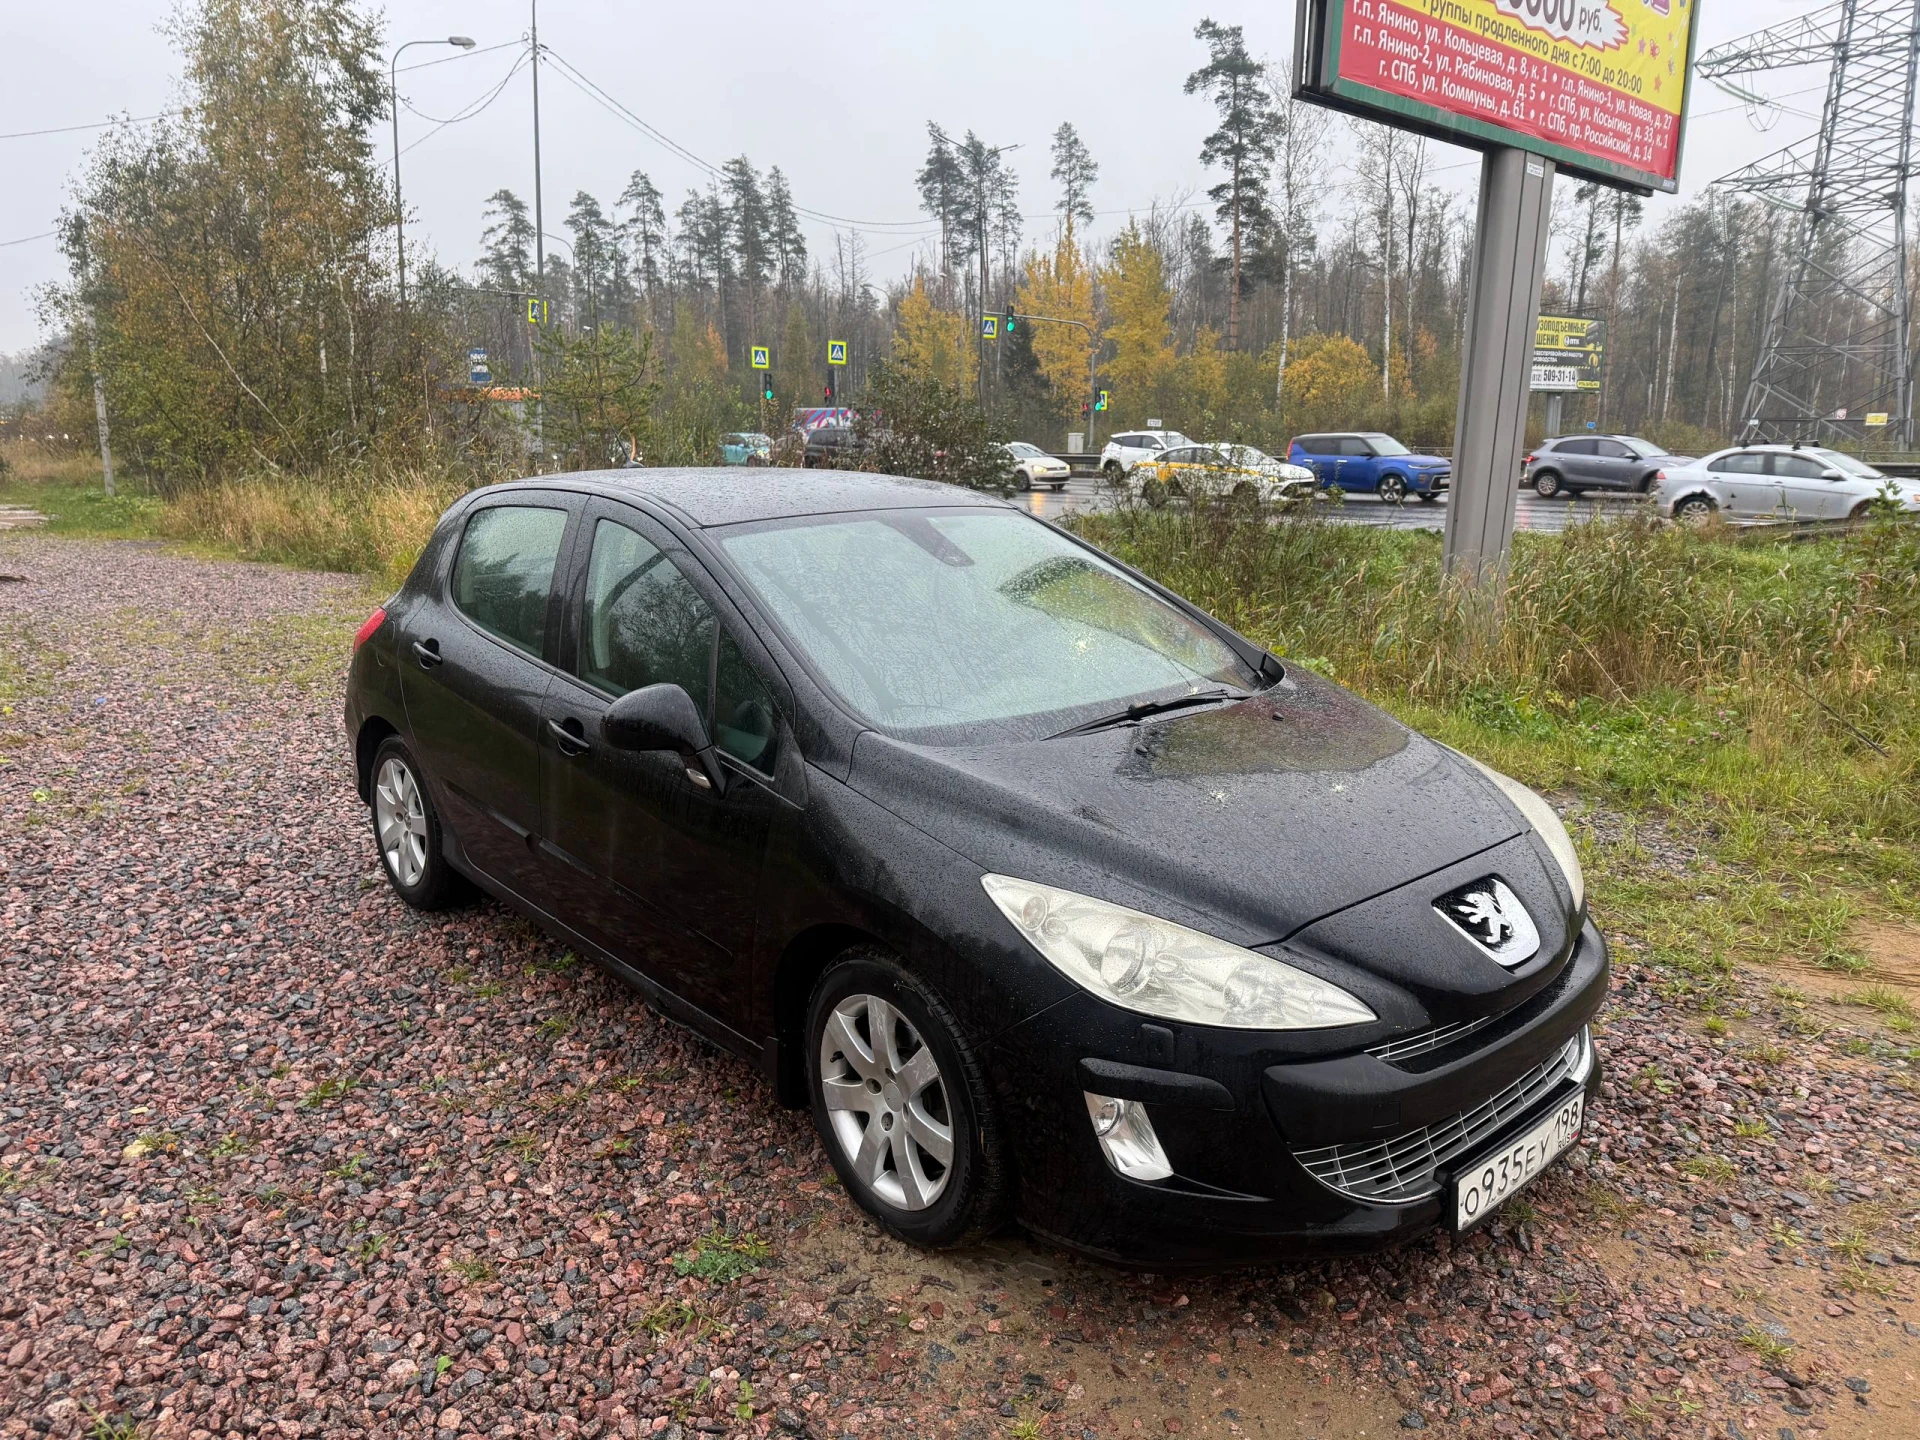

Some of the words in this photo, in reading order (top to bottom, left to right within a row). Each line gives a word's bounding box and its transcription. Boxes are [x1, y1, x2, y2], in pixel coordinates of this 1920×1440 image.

[1475, 12, 1548, 55] продленного
[1551, 46, 1570, 65] дня
[1573, 56, 1578, 68] с
[1581, 52, 1601, 76] 7:00
[1603, 66, 1615, 84] до
[1616, 72, 1642, 94] 20:00
[1579, 5, 1602, 34] руб.
[1353, 0, 1374, 20] г.п.
[1378, 3, 1421, 40] Янино,
[1425, 24, 1441, 44] ул.
[1444, 27, 1505, 69] Кольцевая,
[1507, 56, 1517, 75] д.
[1520, 57, 1529, 80] 8,
[1531, 66, 1539, 81] к.
[1542, 67, 1547, 83] 1
[1561, 77, 1575, 94] г.п.
[1577, 83, 1614, 110] Янино-1,
[1616, 97, 1626, 114] ул.
[1629, 99, 1653, 125] Новая,
[1655, 113, 1663, 130] д.
[1664, 114, 1673, 131] 27
[1353, 24, 1375, 46] г.п.
[1378, 29, 1432, 69] Янино-2,
[1436, 53, 1451, 74] ул.
[1455, 56, 1515, 96] Рябиновая,
[1517, 84, 1527, 101] д.
[1529, 85, 1536, 101] 5
[1549, 93, 1557, 108] г.
[1557, 95, 1578, 117] СПб,
[1579, 104, 1591, 121] ул.
[1593, 109, 1633, 141] Косыгина,
[1634, 127, 1643, 142] д.
[1643, 127, 1654, 145] 33,
[1655, 132, 1663, 147] к.
[1664, 133, 1668, 148] 1
[1379, 59, 1388, 76] г.
[1391, 59, 1418, 90] СПб,
[1422, 74, 1438, 94] ул.
[1441, 76, 1497, 115] Коммуны,
[1500, 99, 1510, 118] д.
[1513, 101, 1525, 119] 61
[1539, 113, 1546, 126] г.
[1547, 112, 1568, 136] СПб,
[1569, 123, 1582, 141] пр.
[1584, 125, 1632, 158] Российский,
[1633, 146, 1642, 162] д.
[1643, 147, 1652, 163] 14
[1538, 319, 1586, 334] ЗОПОДЪЕМНЫЕ
[1543, 369, 1576, 382] 509-31-14
[1464, 1131, 1551, 1216] О935ЕУ
[1553, 1100, 1579, 1140] 198
[1557, 1133, 1571, 1151] RUS
